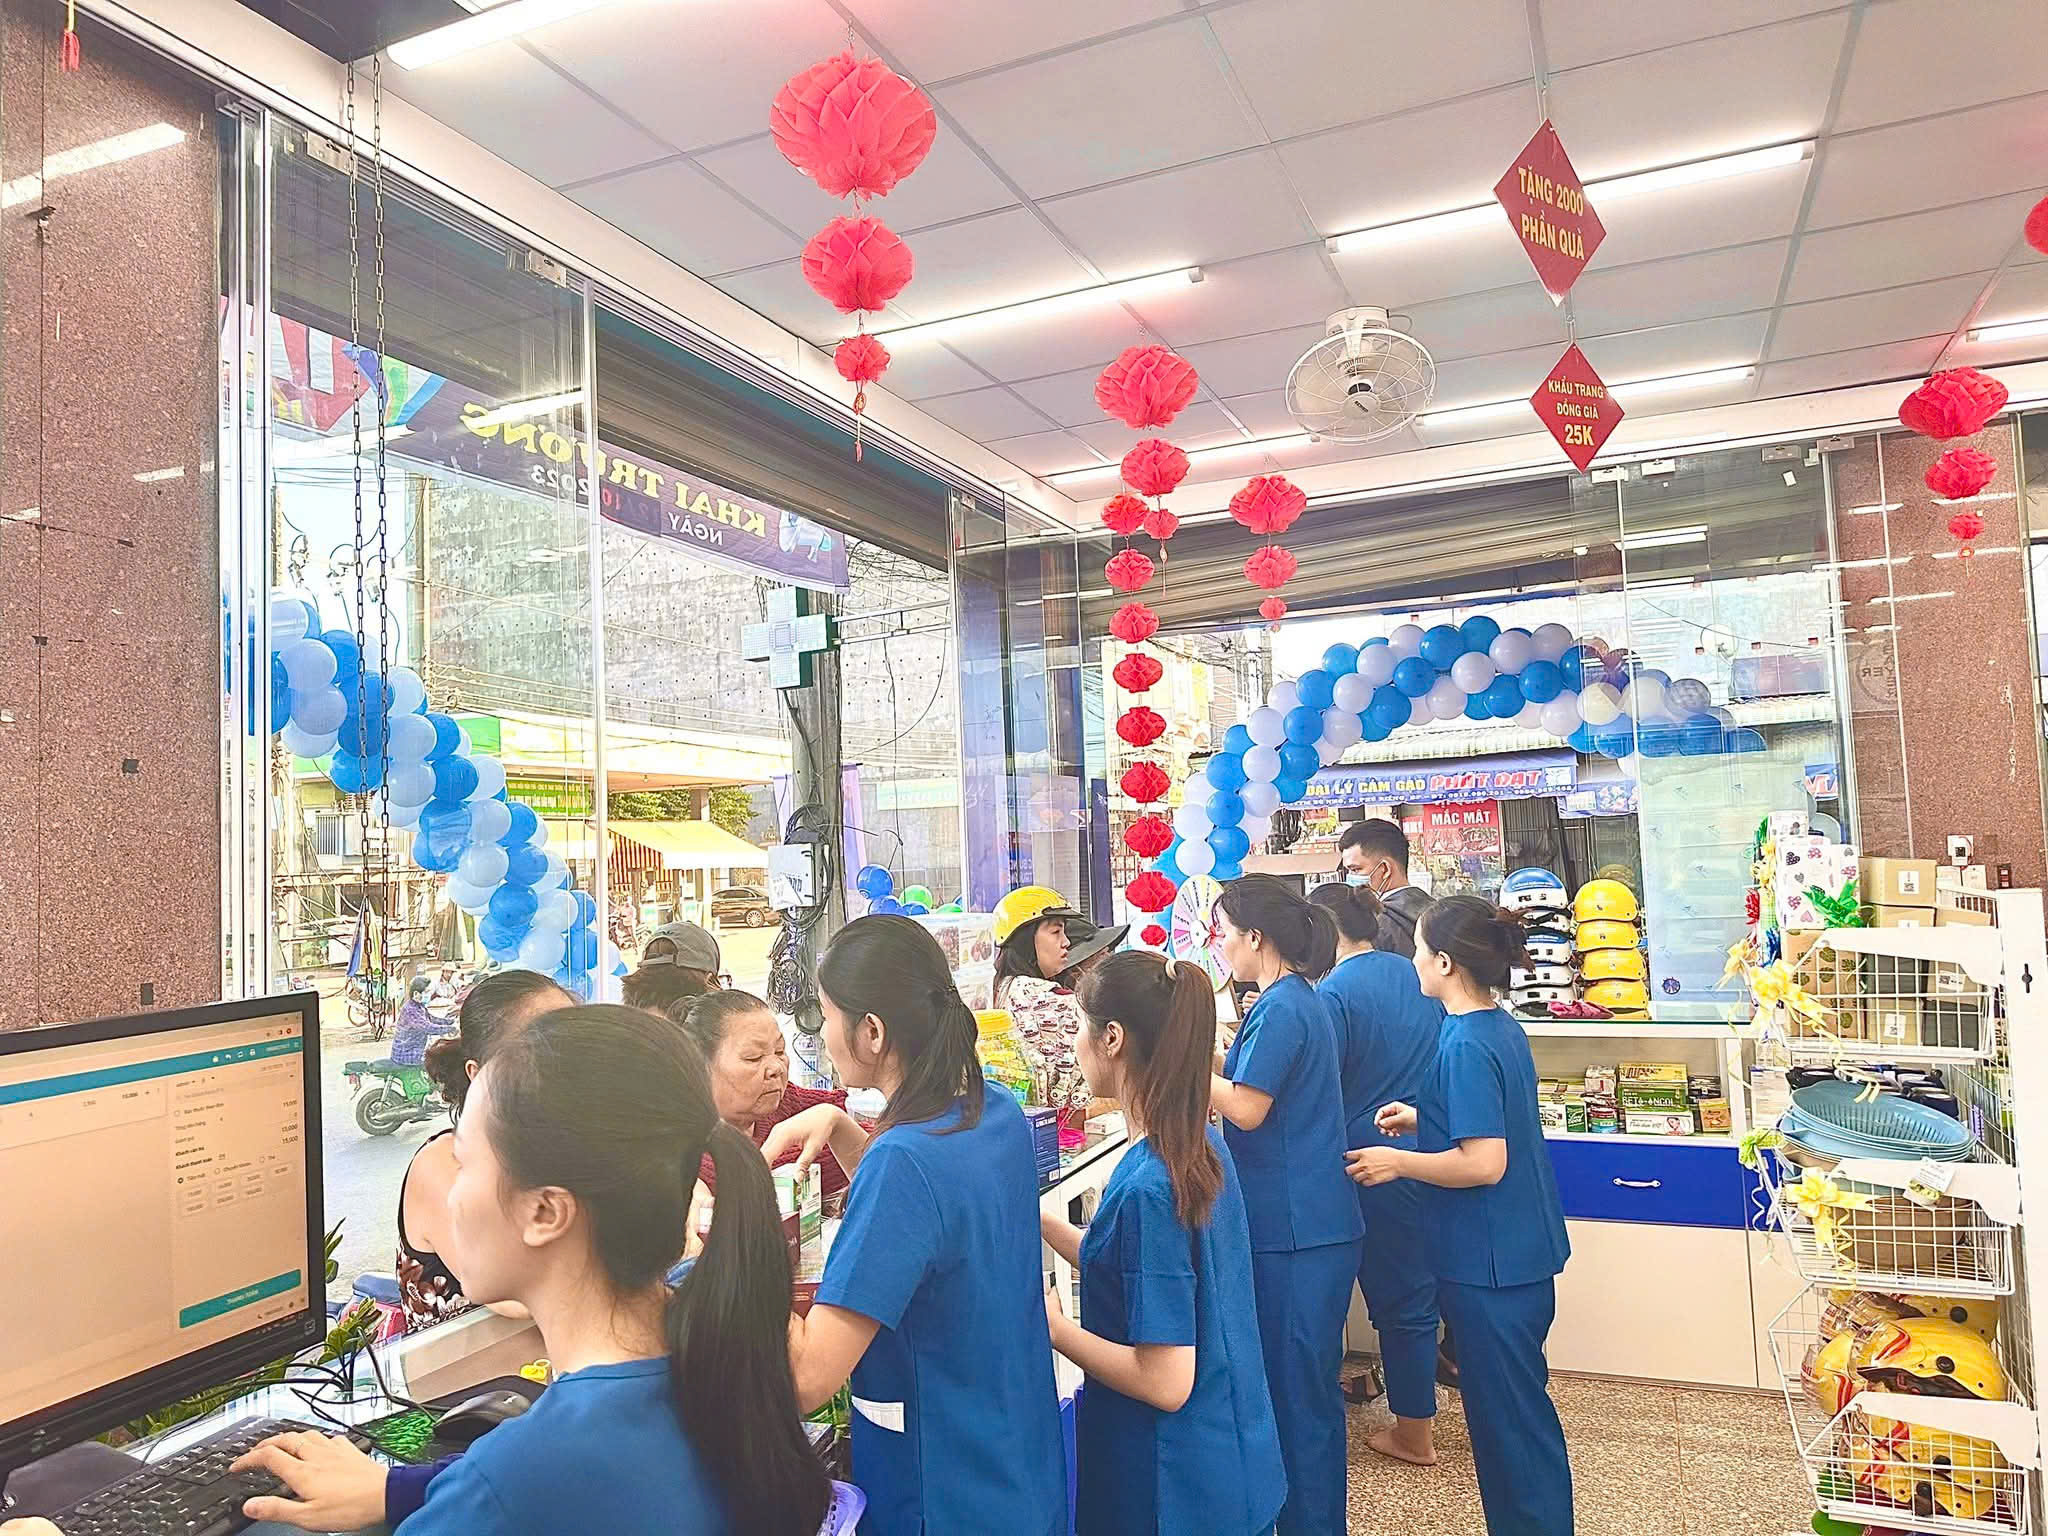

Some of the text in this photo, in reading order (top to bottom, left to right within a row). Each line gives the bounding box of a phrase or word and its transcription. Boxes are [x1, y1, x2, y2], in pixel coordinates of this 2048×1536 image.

[1518, 164, 1584, 217] TẶNG 2000
[1521, 209, 1585, 260] PHẦN QUÀ
[1548, 375, 1604, 398] KHẨU TRANG
[1556, 398, 1599, 419] ĐỒNG GIÁ
[1564, 424, 1595, 446] 25K
[1333, 778, 1354, 795] LÝ
[1395, 778, 1426, 793] GẠO
[1430, 770, 1491, 792] PHÁT
[1494, 770, 1542, 790] ĐẠT
